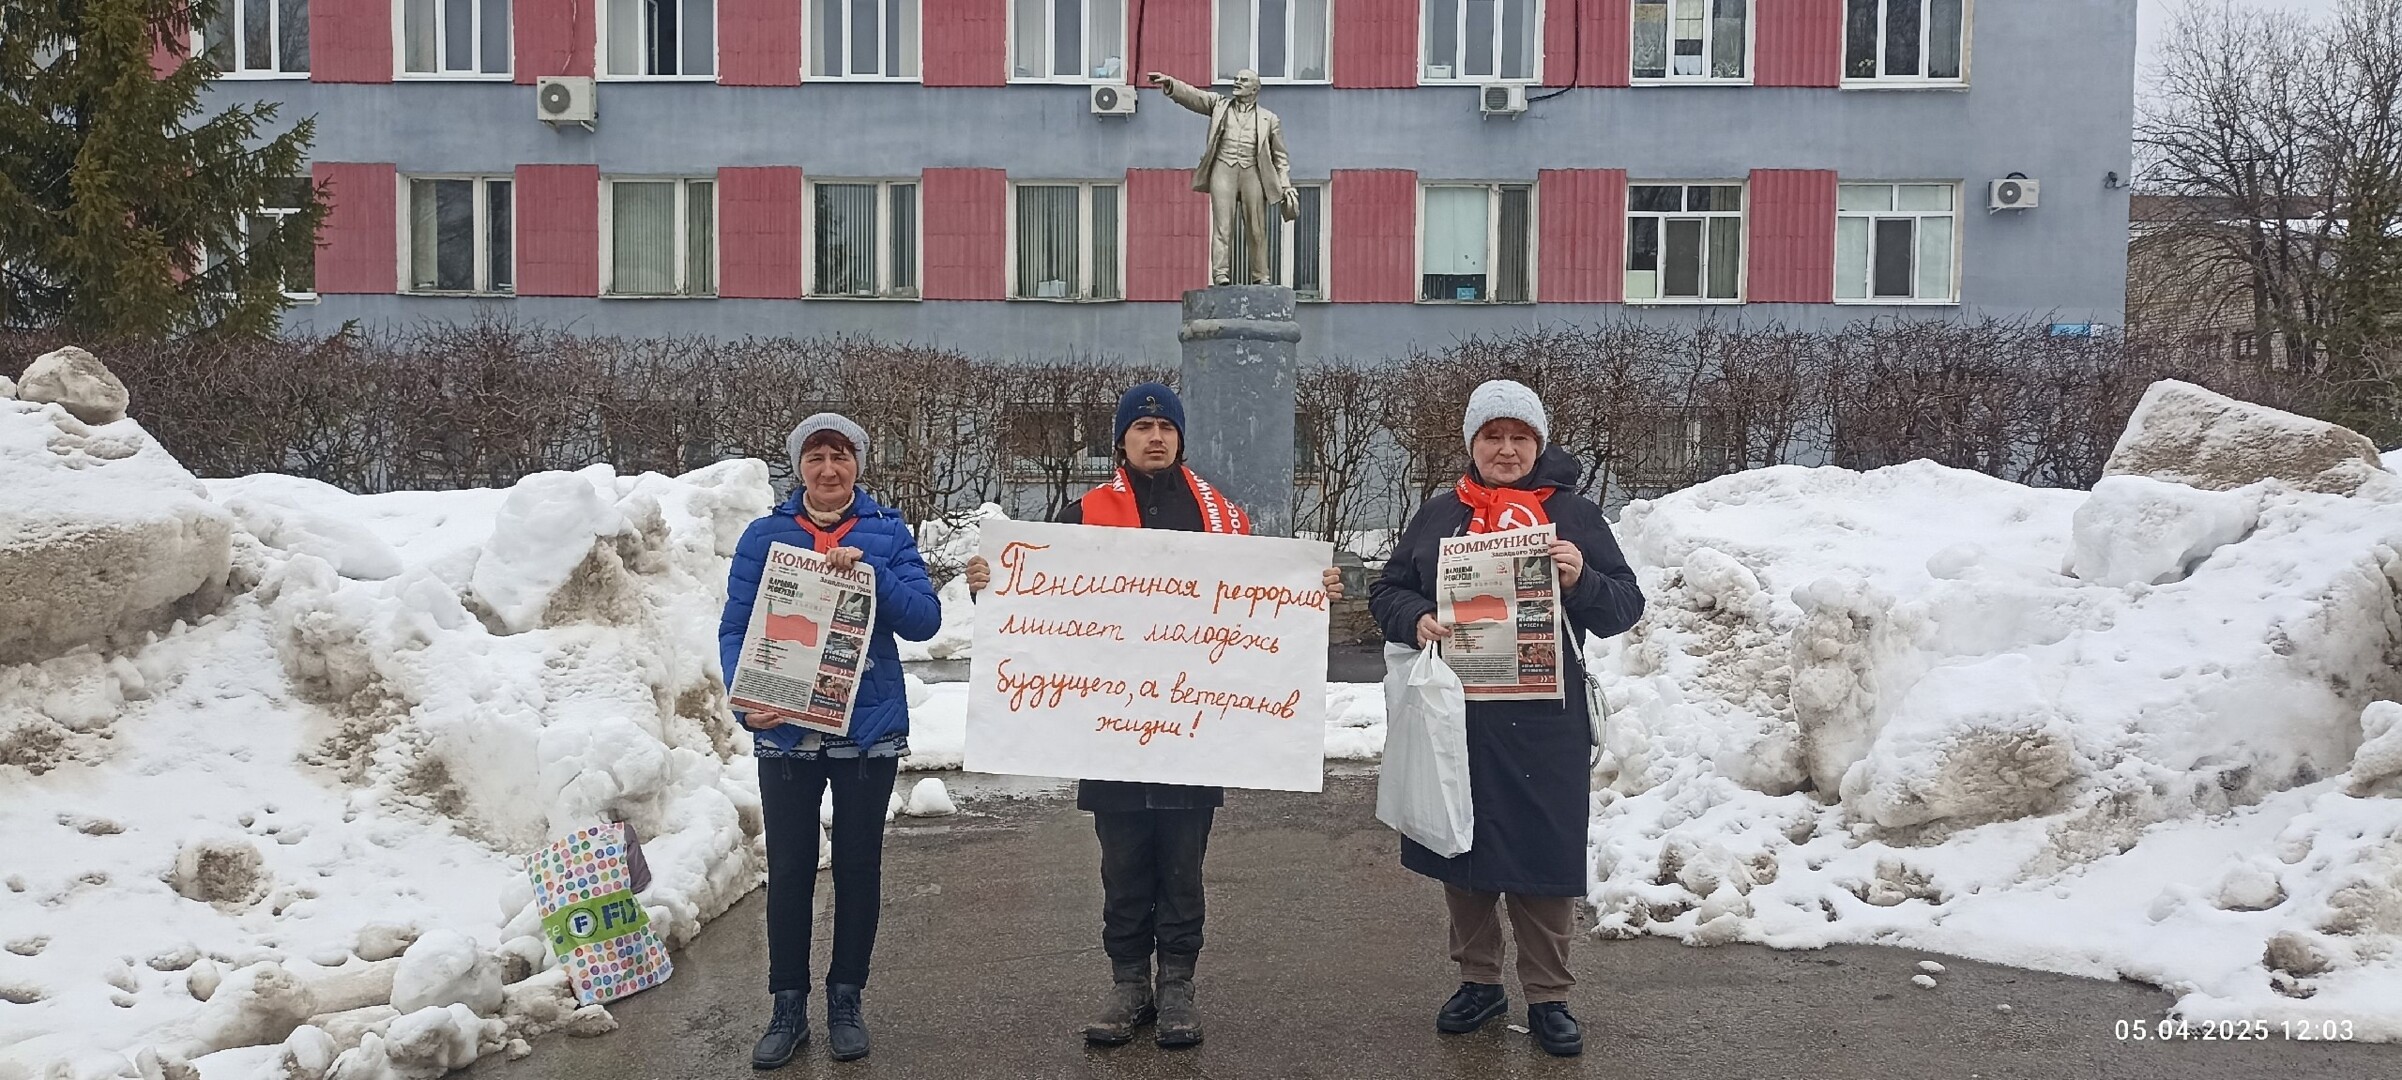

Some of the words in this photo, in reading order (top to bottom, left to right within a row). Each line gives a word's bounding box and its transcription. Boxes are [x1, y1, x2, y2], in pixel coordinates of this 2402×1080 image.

[1443, 532, 1550, 556] КОММУНИСТ
[995, 541, 1202, 598] Пенсионная
[1212, 580, 1327, 618] реформа
[998, 614, 1124, 642] лишает
[1143, 621, 1280, 664] молодёжь
[996, 658, 1133, 712] будущего,
[1139, 681, 1160, 699] а
[1170, 672, 1301, 720] ветеранов
[1095, 711, 1203, 746] жизни!
